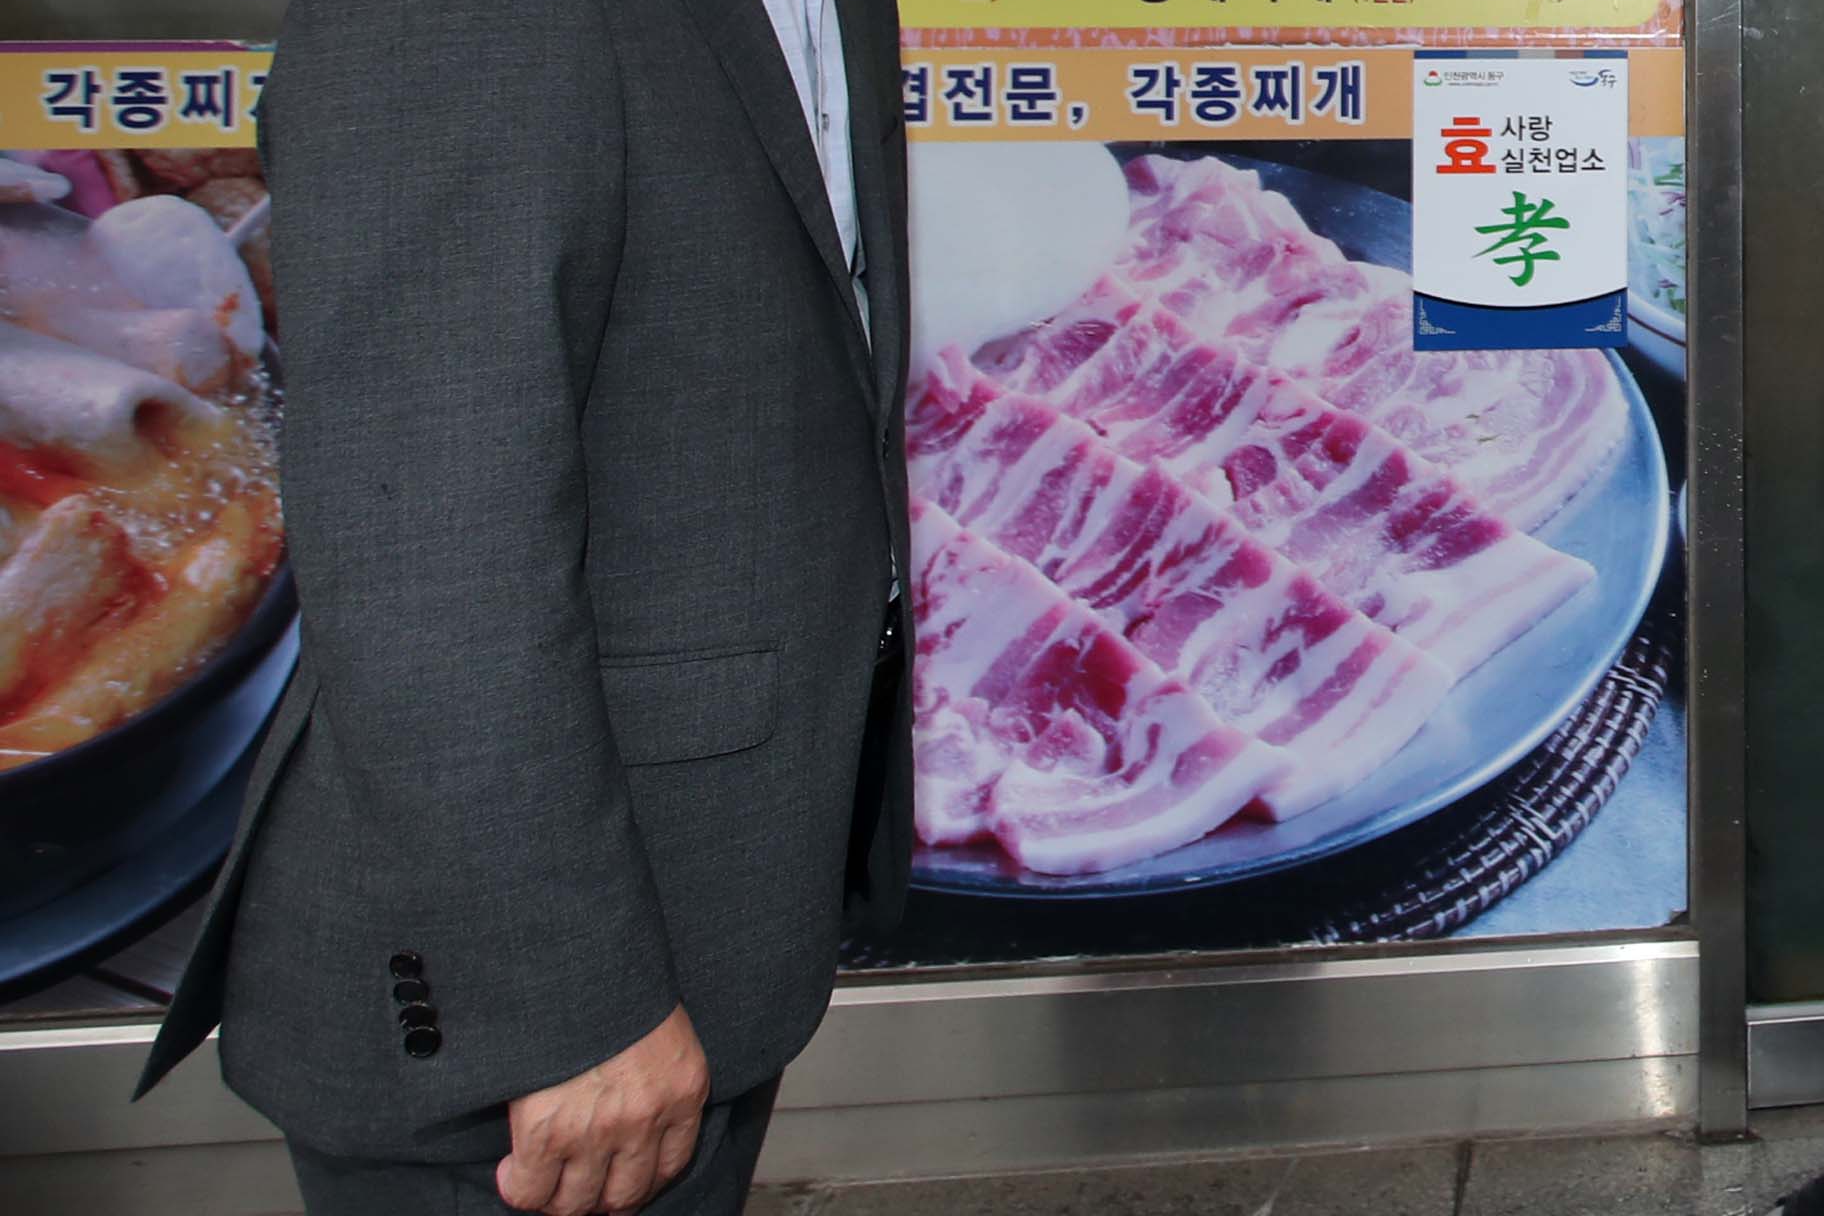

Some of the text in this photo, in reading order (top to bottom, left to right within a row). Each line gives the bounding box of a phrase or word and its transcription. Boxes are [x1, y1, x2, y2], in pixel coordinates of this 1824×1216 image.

[1129, 61, 1364, 125] 각종찌개
[1444, 72, 1485, 81] 인천광역시
[1436, 115, 1552, 173] 효 사랑
[1501, 148, 1606, 174] 실천업소
[1474, 191, 1569, 288] 孝
